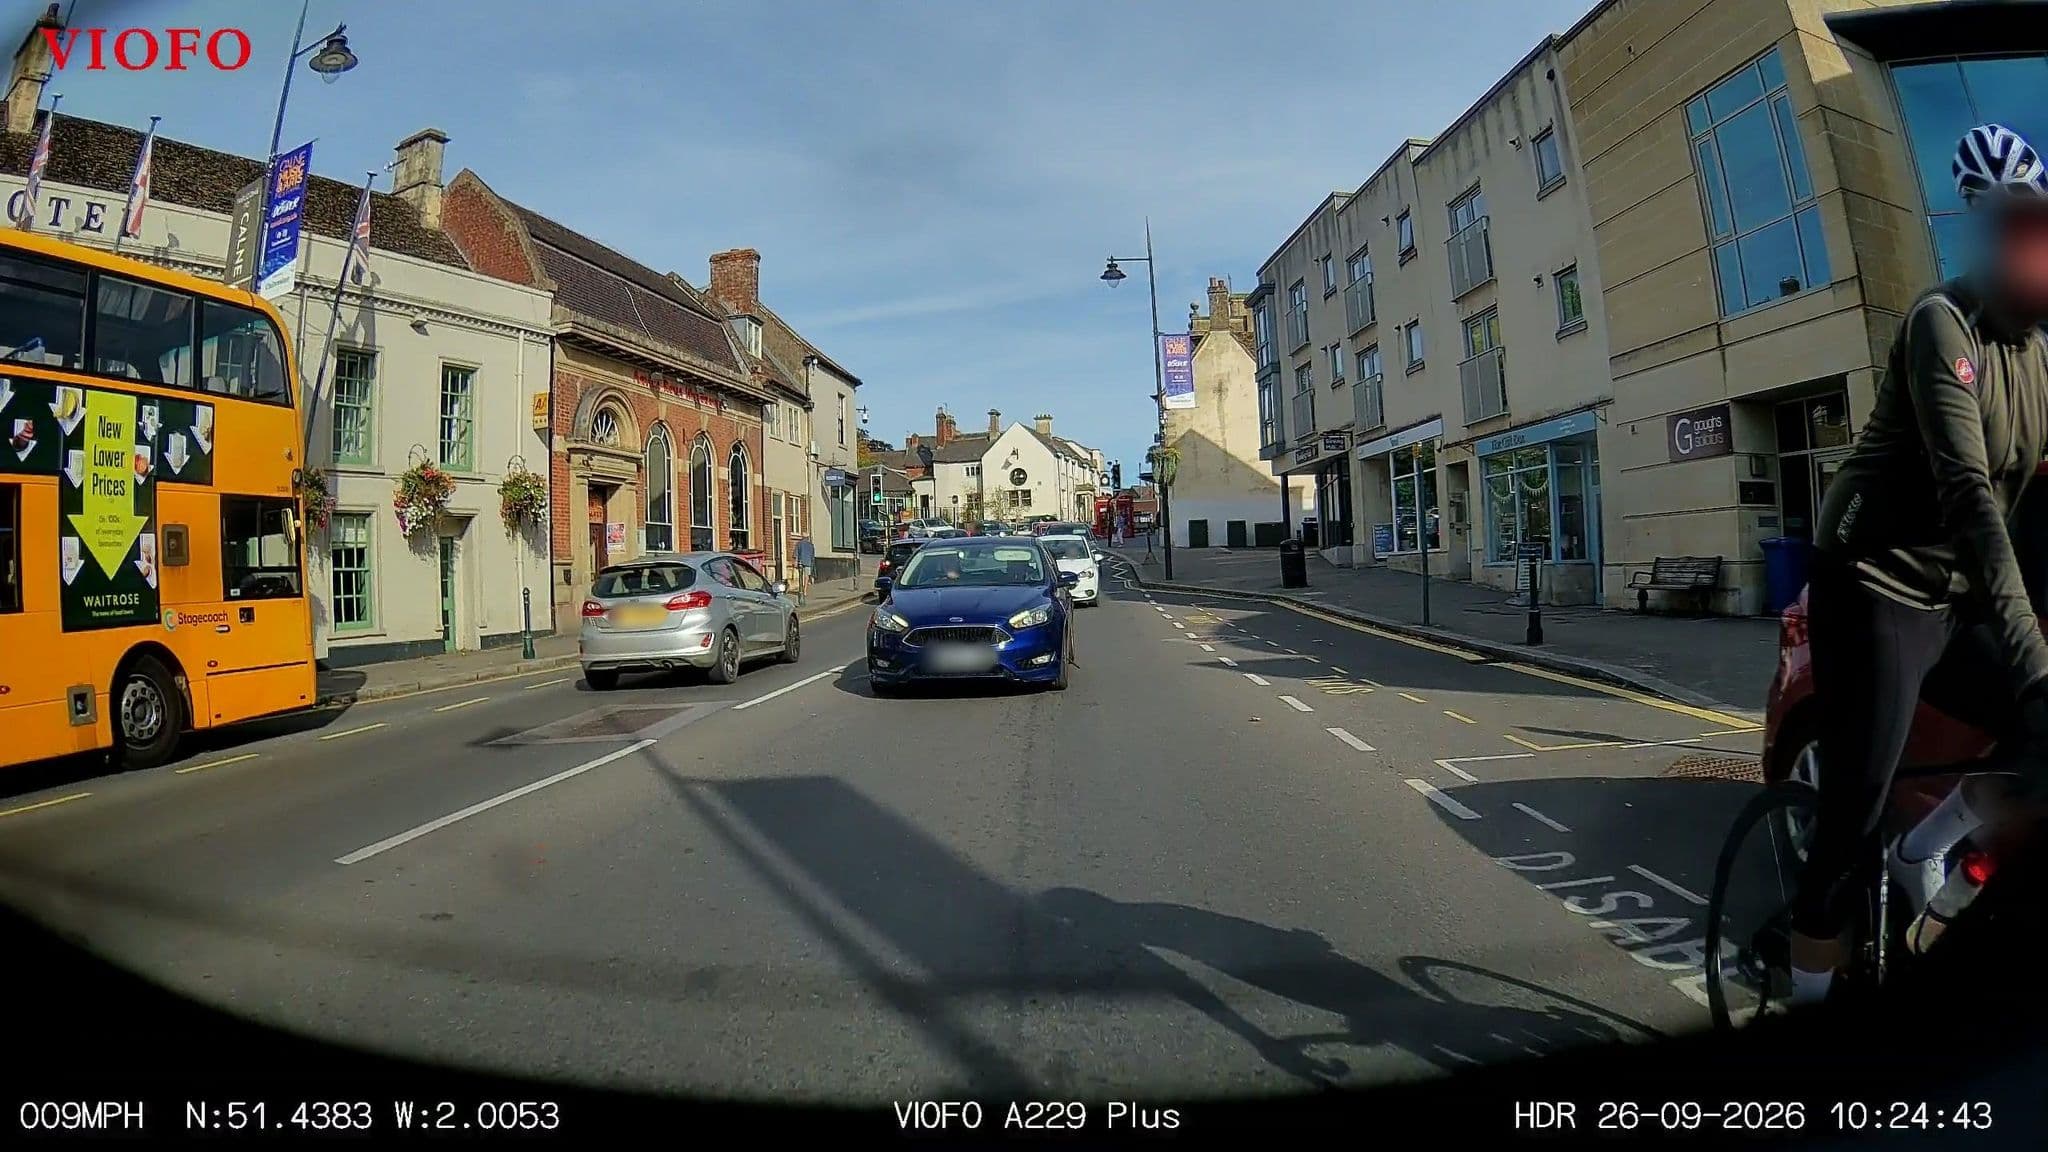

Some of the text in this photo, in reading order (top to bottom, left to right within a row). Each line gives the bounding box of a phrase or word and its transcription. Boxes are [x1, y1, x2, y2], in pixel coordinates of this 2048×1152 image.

[233, 212, 250, 278] CALNE
[98, 415, 122, 439] New
[93, 443, 125, 468] Lower
[92, 472, 126, 496] Prices
[83, 593, 140, 608] WAITROSE
[177, 610, 229, 627] Stagecoach
